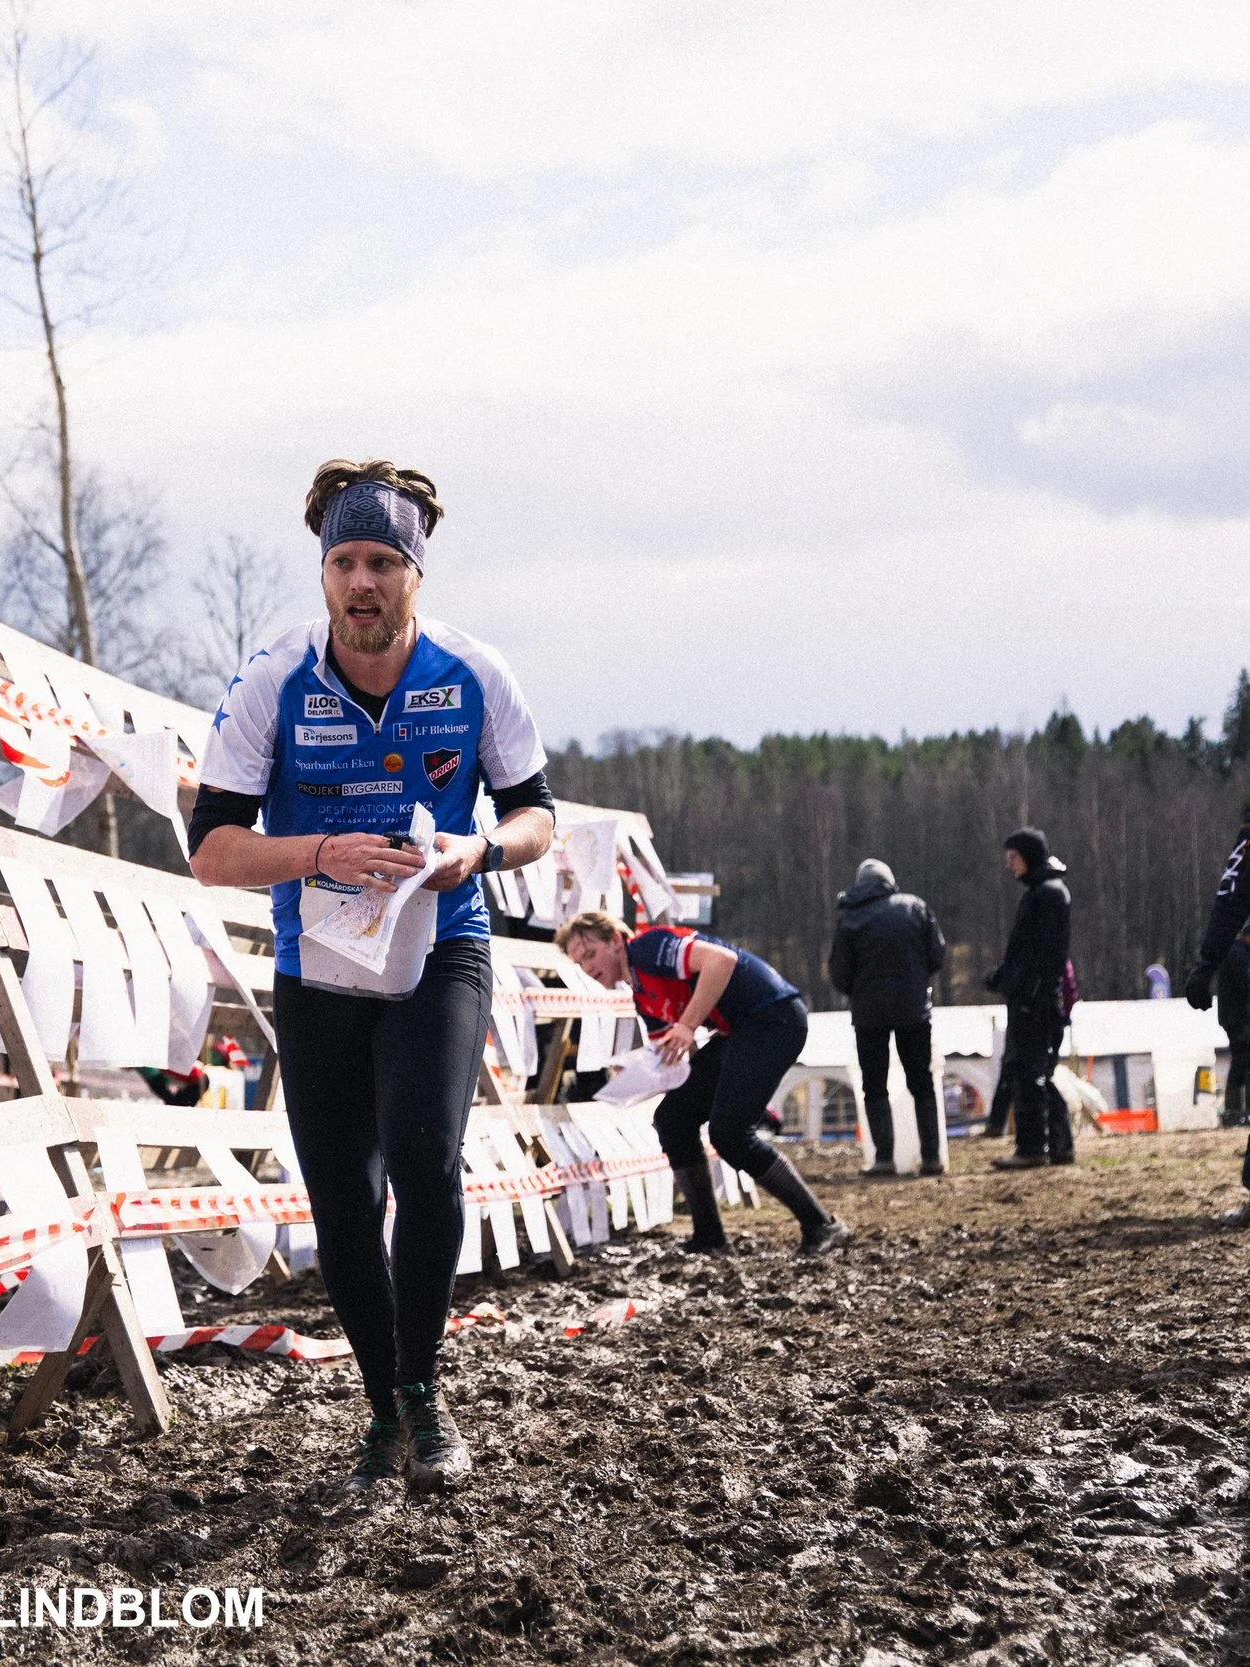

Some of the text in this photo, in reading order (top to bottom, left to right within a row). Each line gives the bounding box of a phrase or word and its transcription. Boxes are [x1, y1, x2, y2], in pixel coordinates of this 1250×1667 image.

[410, 687, 455, 707] EKSX
[415, 724, 469, 736] LF Blekinge
[295, 759, 375, 771] Sparbanken Eken
[431, 757, 458, 780] ORION
[318, 801, 434, 815] DESTINATION KOTA
